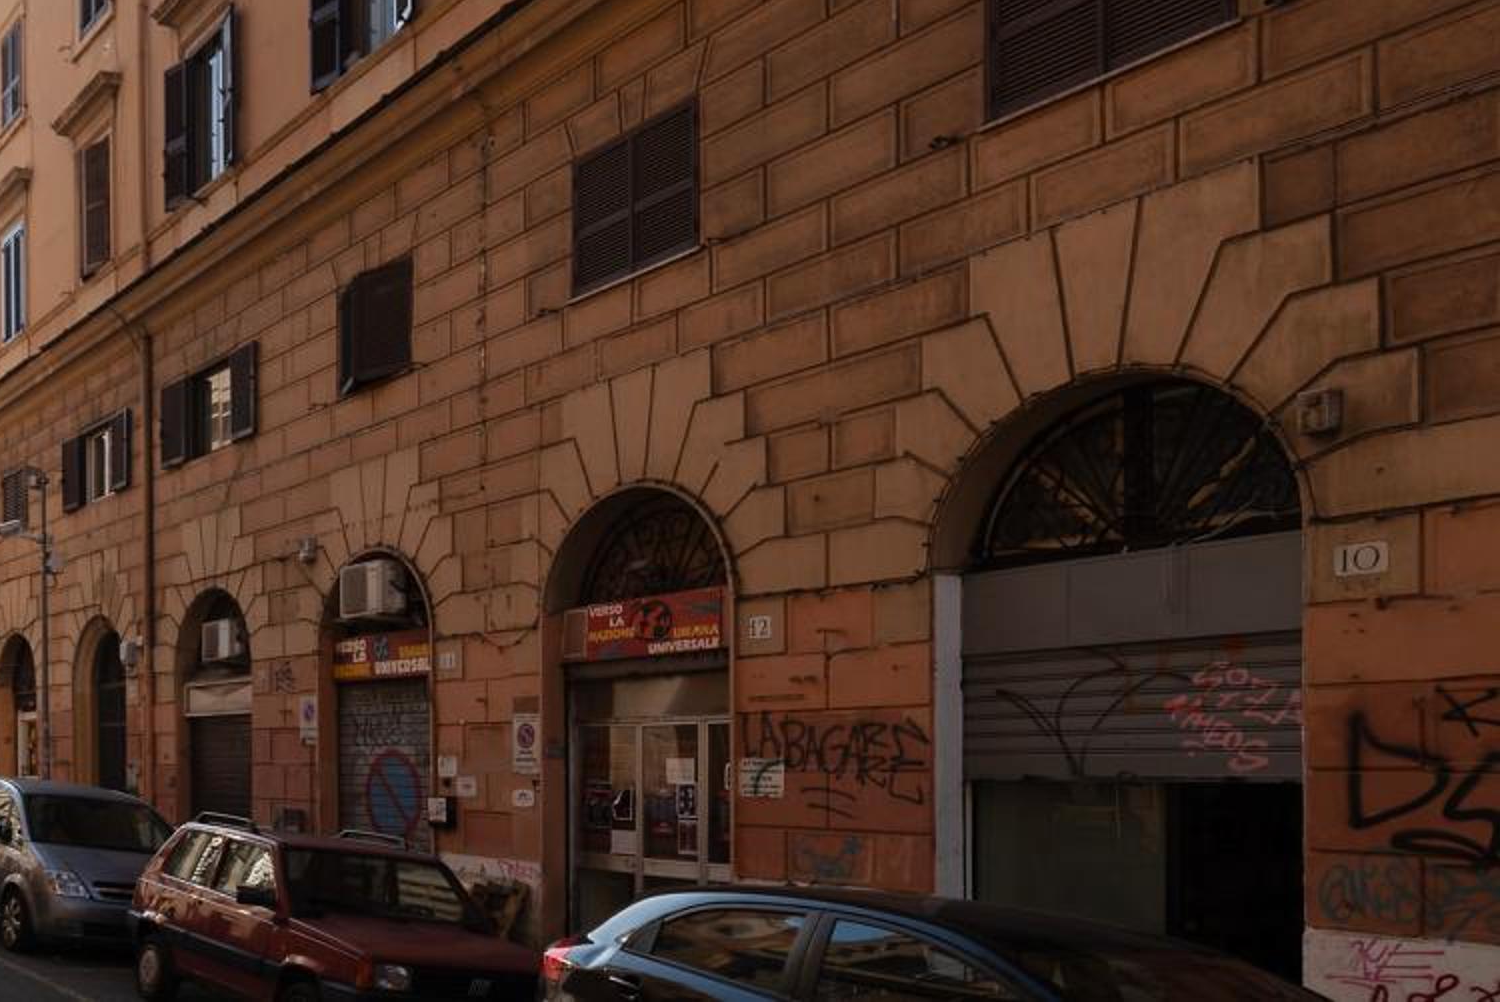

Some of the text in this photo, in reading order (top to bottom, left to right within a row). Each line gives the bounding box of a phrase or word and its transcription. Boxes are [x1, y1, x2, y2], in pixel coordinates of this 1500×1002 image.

[1341, 545, 1380, 572] 10
[588, 604, 623, 617] VERSO
[608, 618, 625, 628] LA
[647, 637, 720, 655] UNIVERSALE
